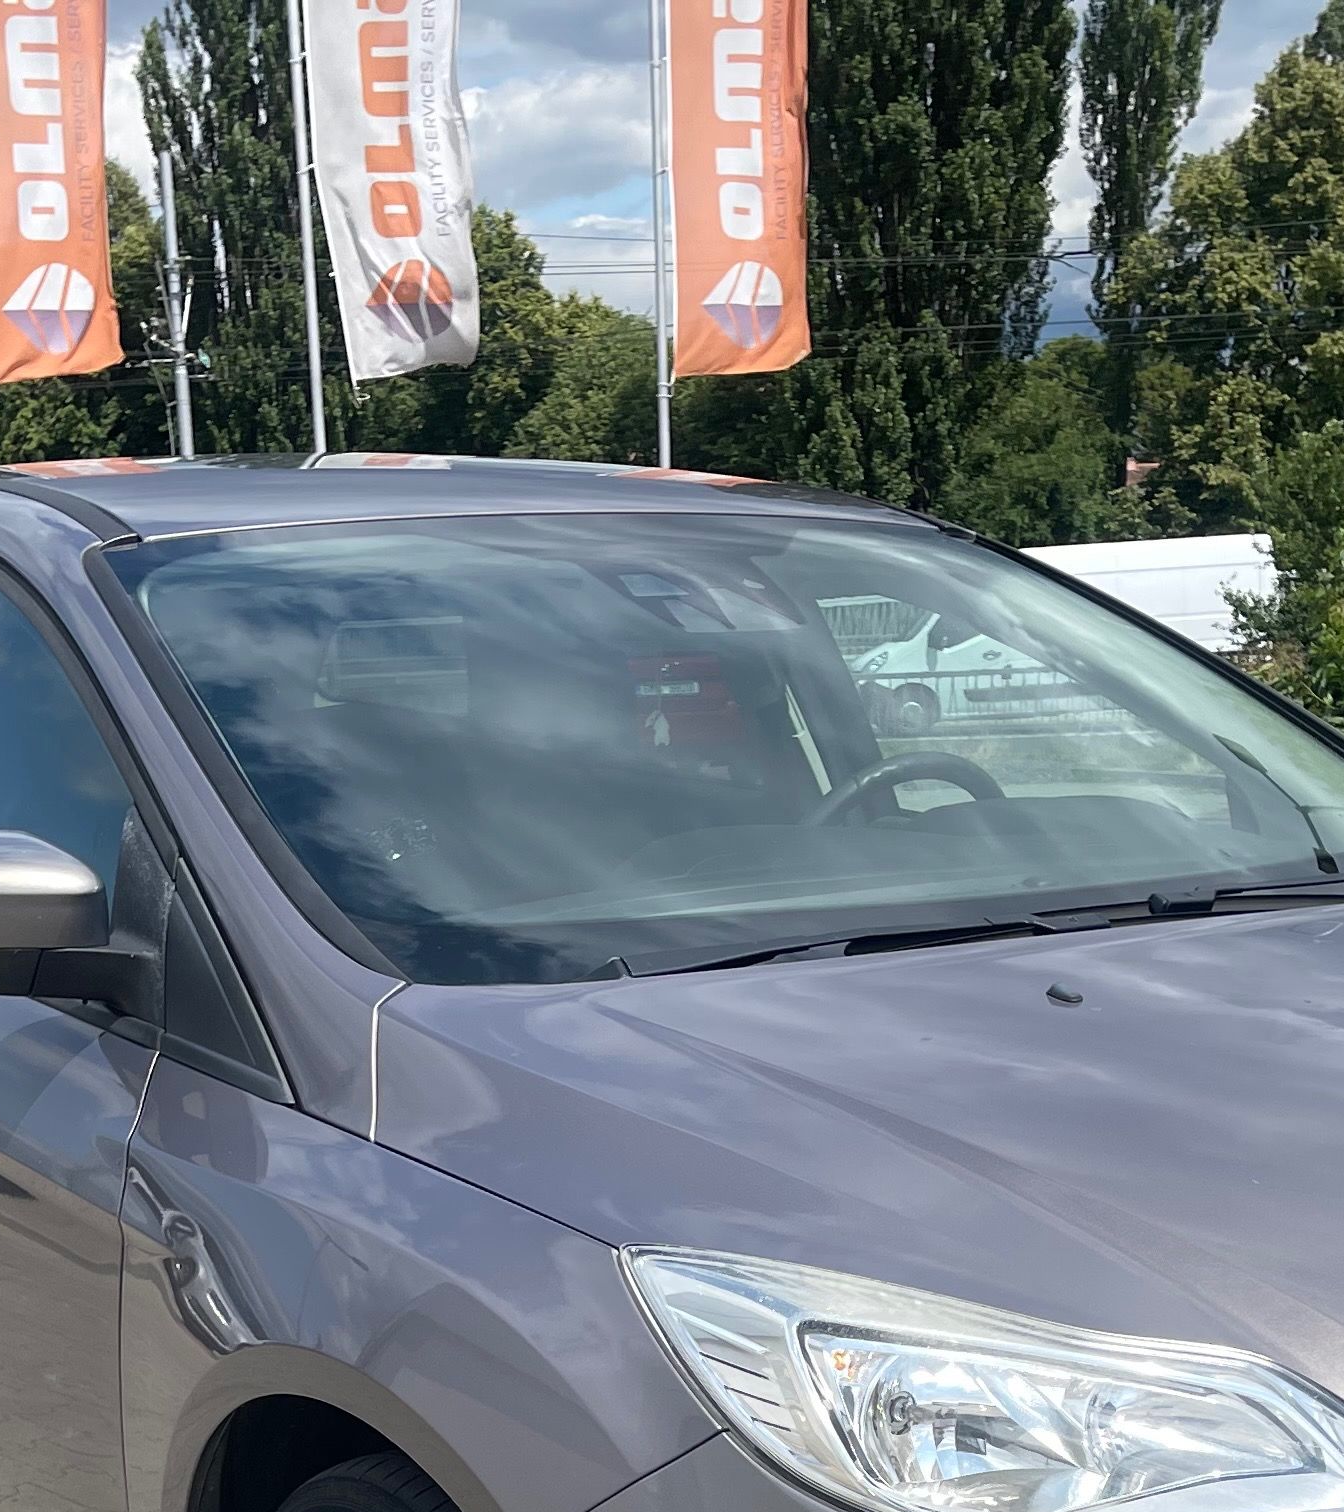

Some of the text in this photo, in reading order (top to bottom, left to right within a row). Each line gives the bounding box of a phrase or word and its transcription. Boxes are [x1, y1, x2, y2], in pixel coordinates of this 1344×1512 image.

[66, 0, 96, 242] FACILITY SERVICES SER
[420, 61, 441, 154] SERVICES
[427, 160, 451, 237] FACILITY
[773, 165, 788, 240] FACILITY
